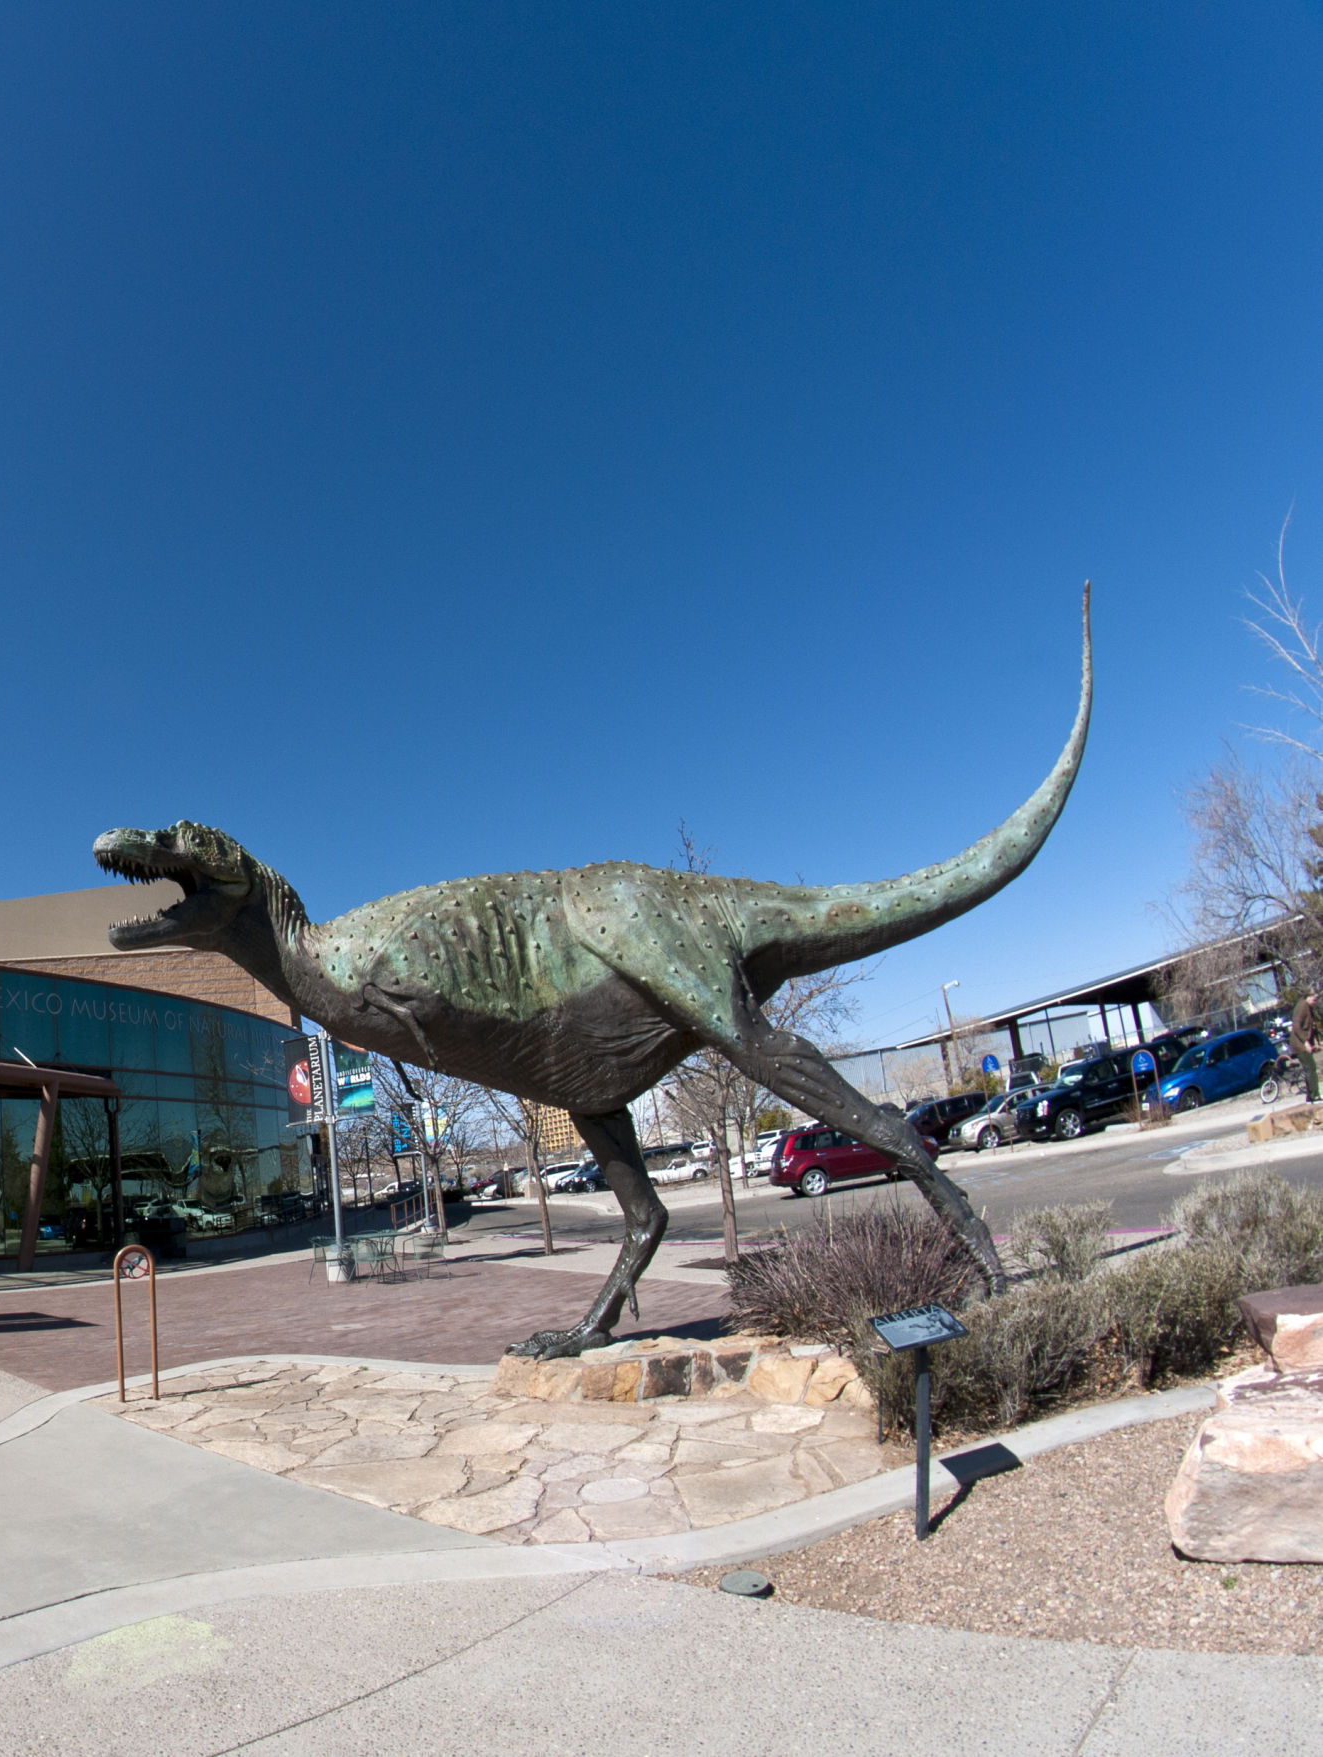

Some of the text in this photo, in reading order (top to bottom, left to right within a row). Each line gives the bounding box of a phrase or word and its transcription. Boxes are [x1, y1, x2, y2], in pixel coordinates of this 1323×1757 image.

[71, 999, 159, 1028] MUSEUM
[164, 1010, 183, 1031] OF
[307, 1035, 324, 1122] PLANETARIUM
[875, 1304, 941, 1328] ALBERTA
